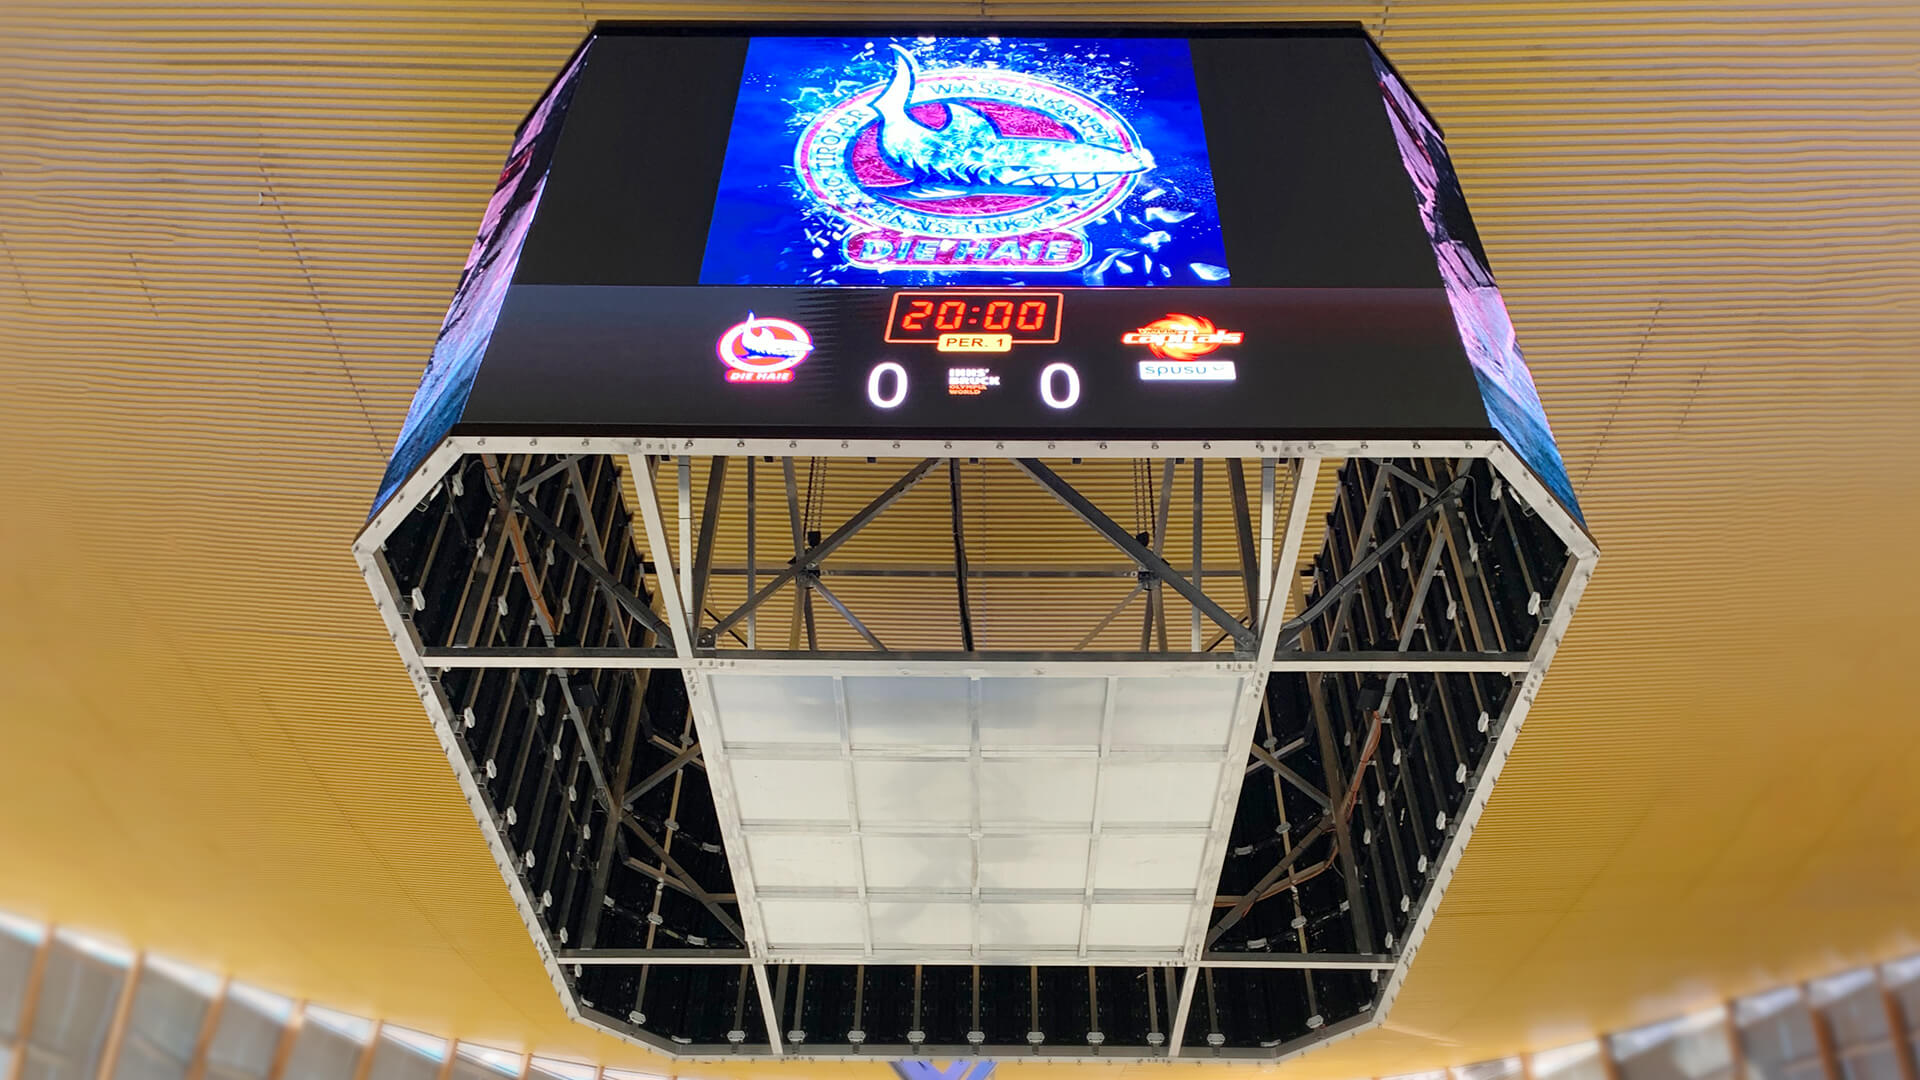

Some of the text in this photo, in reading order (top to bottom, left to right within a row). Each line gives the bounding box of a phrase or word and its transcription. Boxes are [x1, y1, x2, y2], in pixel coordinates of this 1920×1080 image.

[815, 109, 869, 172] TIROLER
[930, 83, 1118, 145] WASSERKRAFT
[859, 238, 1073, 261] DIE HAIE
[902, 300, 1048, 331] 20:00
[946, 337, 1004, 348] PER. 1
[730, 372, 753, 380] DIE
[949, 376, 1000, 385] BRUCK
[1144, 366, 1207, 376] spusu
[867, 362, 908, 409] 0
[1040, 362, 1080, 409] 0
